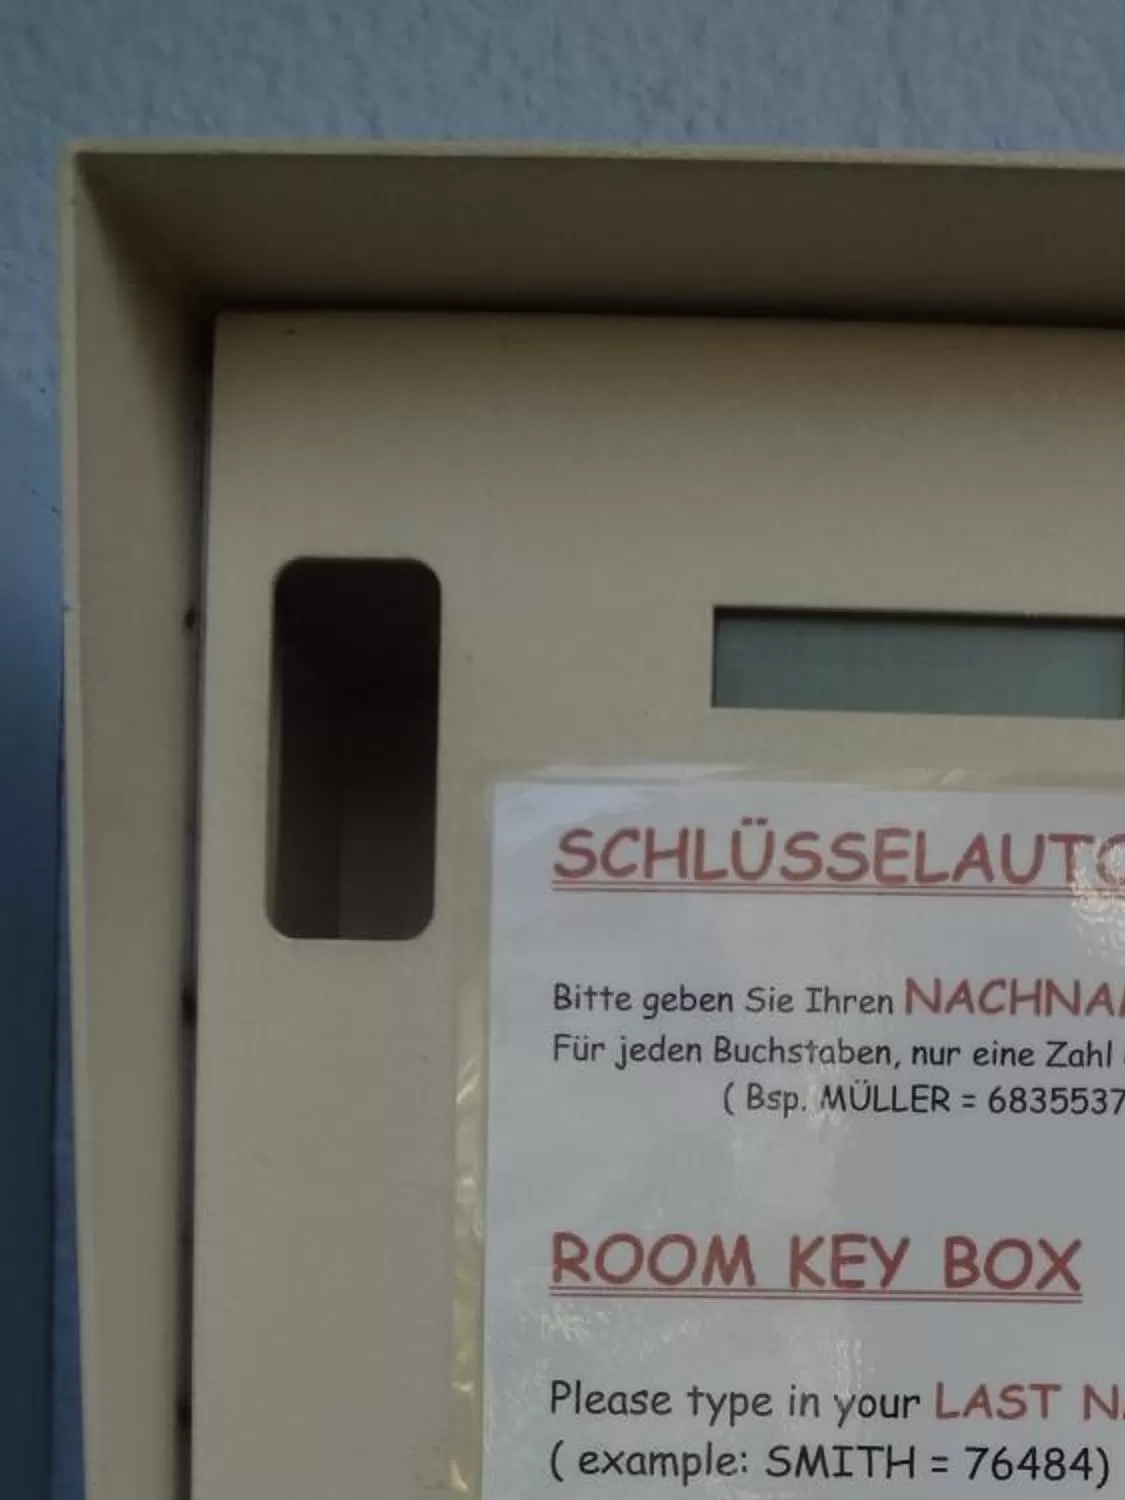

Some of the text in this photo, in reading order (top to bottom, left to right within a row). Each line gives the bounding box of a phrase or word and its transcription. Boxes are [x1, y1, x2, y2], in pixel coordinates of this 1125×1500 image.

[553, 984, 632, 1013] Bitte
[642, 987, 734, 1019] geben
[746, 987, 793, 1014] Sie
[806, 988, 894, 1016] Ihren
[552, 1036, 605, 1063] Für
[615, 1036, 703, 1069] jeden
[713, 1037, 901, 1069] Buchstaben,
[911, 1046, 962, 1066] nur
[972, 1043, 1035, 1068] eine
[1045, 1040, 1114, 1069] Zahl
[819, 1079, 952, 1114] MÜLLER
[550, 1231, 1082, 1292] ROOM KEY BOX
[550, 1381, 671, 1417] Please
[688, 1388, 773, 1426] type
[789, 1390, 819, 1418] in
[834, 1394, 920, 1428] your
[934, 1382, 1061, 1420] LAST
[576, 1447, 749, 1487] example:
[765, 1446, 916, 1479] SMITH
[963, 1446, 1111, 1487] 76484)
